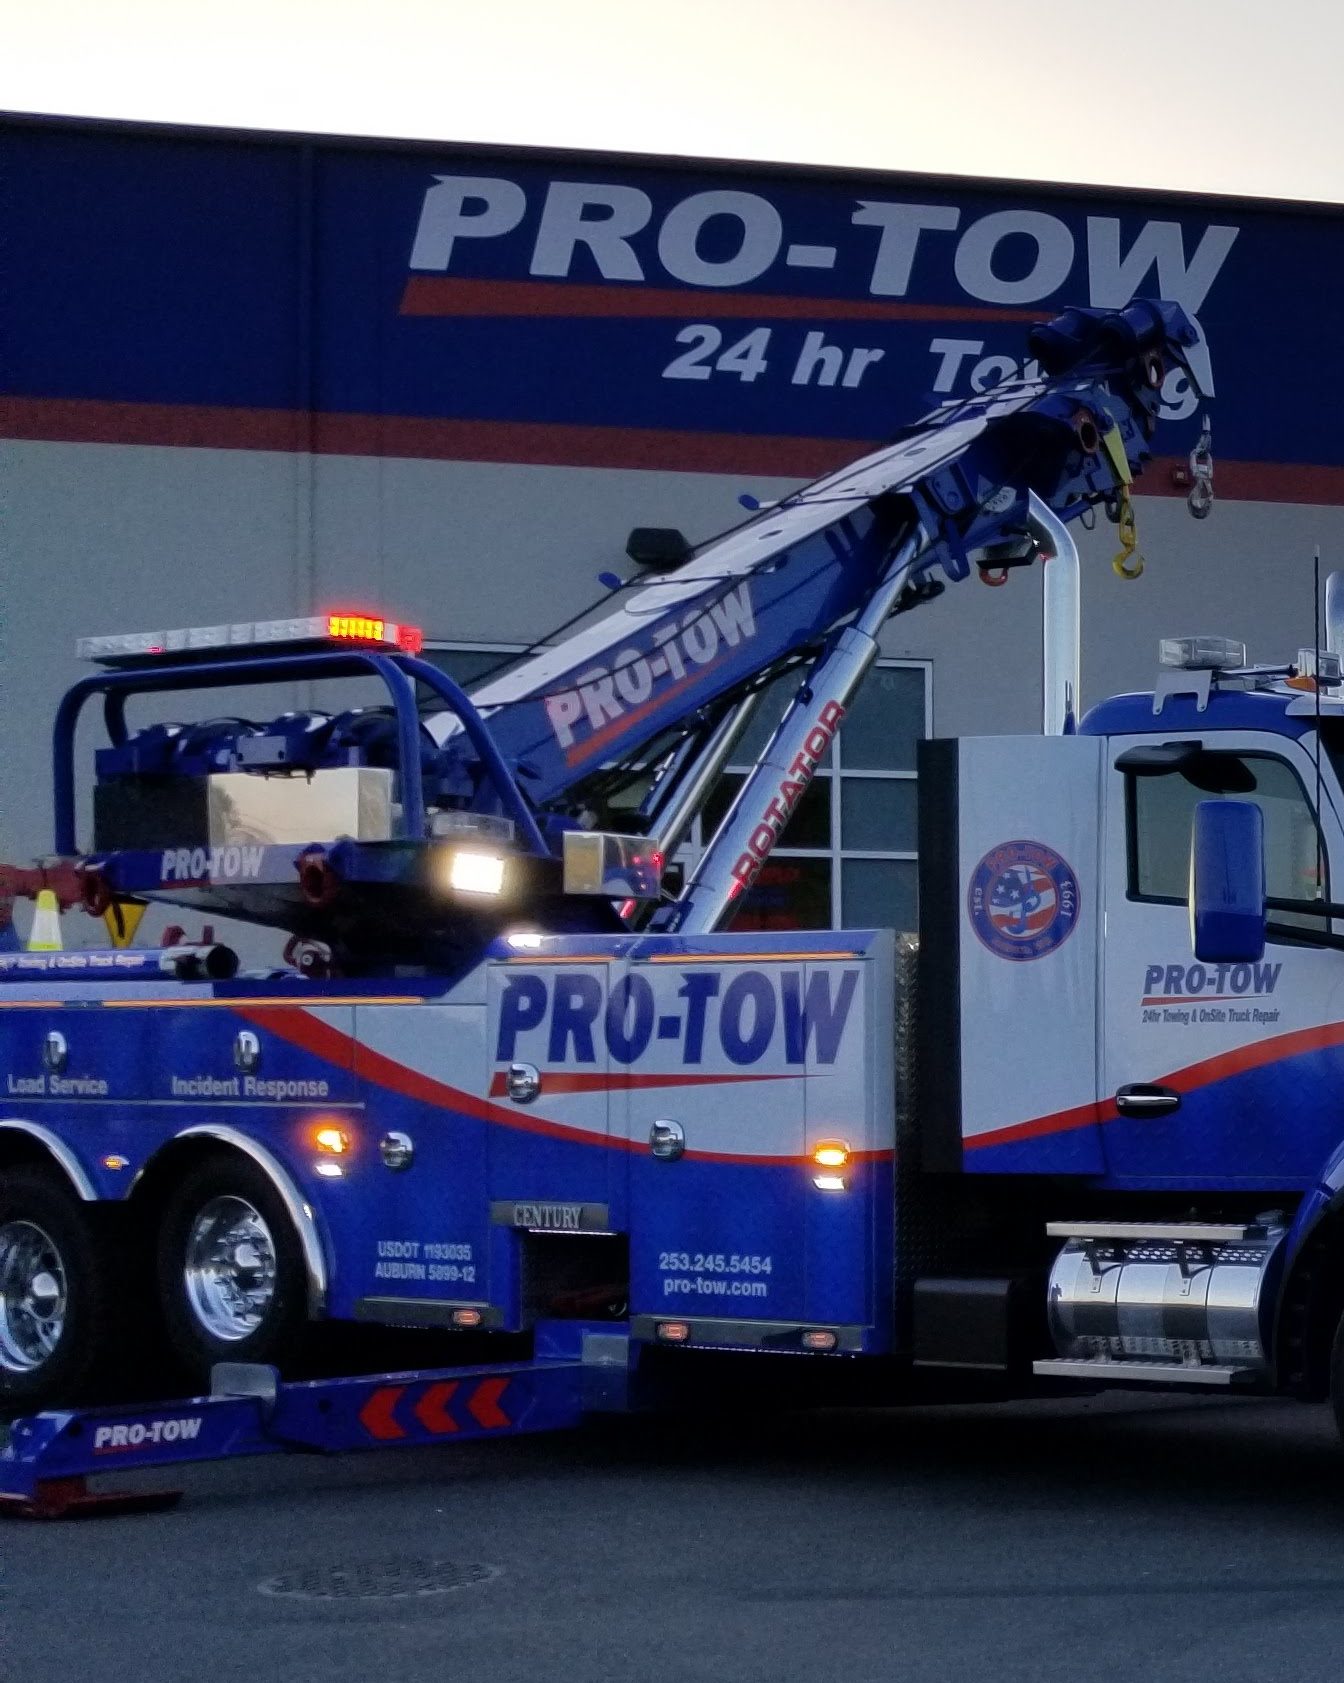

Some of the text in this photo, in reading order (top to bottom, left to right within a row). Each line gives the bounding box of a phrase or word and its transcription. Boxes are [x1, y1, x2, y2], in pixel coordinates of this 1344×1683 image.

[409, 174, 1240, 315] PRO-TOW
[662, 324, 1200, 420] 24 hr Tog
[544, 579, 756, 749] PRO-TOW
[730, 699, 847, 890] ROTATOR
[161, 846, 266, 882] PRO-TOW
[1143, 963, 1283, 995] PRO-TOW
[495, 970, 861, 1066] PRO-TOW
[1163, 1009, 1189, 1025] Towing
[1199, 1008, 1226, 1023] OnSite
[1228, 1008, 1251, 1022] Truck
[1252, 1008, 1281, 1025] Repair
[50, 1075, 108, 1096] Service
[172, 1075, 240, 1096] Incident
[244, 1076, 329, 1100] Response
[513, 1203, 582, 1229] CENTURY
[377, 1241, 419, 1258] USDOT
[659, 1252, 772, 1275] 253.245.5454
[375, 1262, 426, 1280] AUBURN
[663, 1276, 768, 1297] pro-tow.com
[94, 1417, 202, 1449] PRO-TOW
